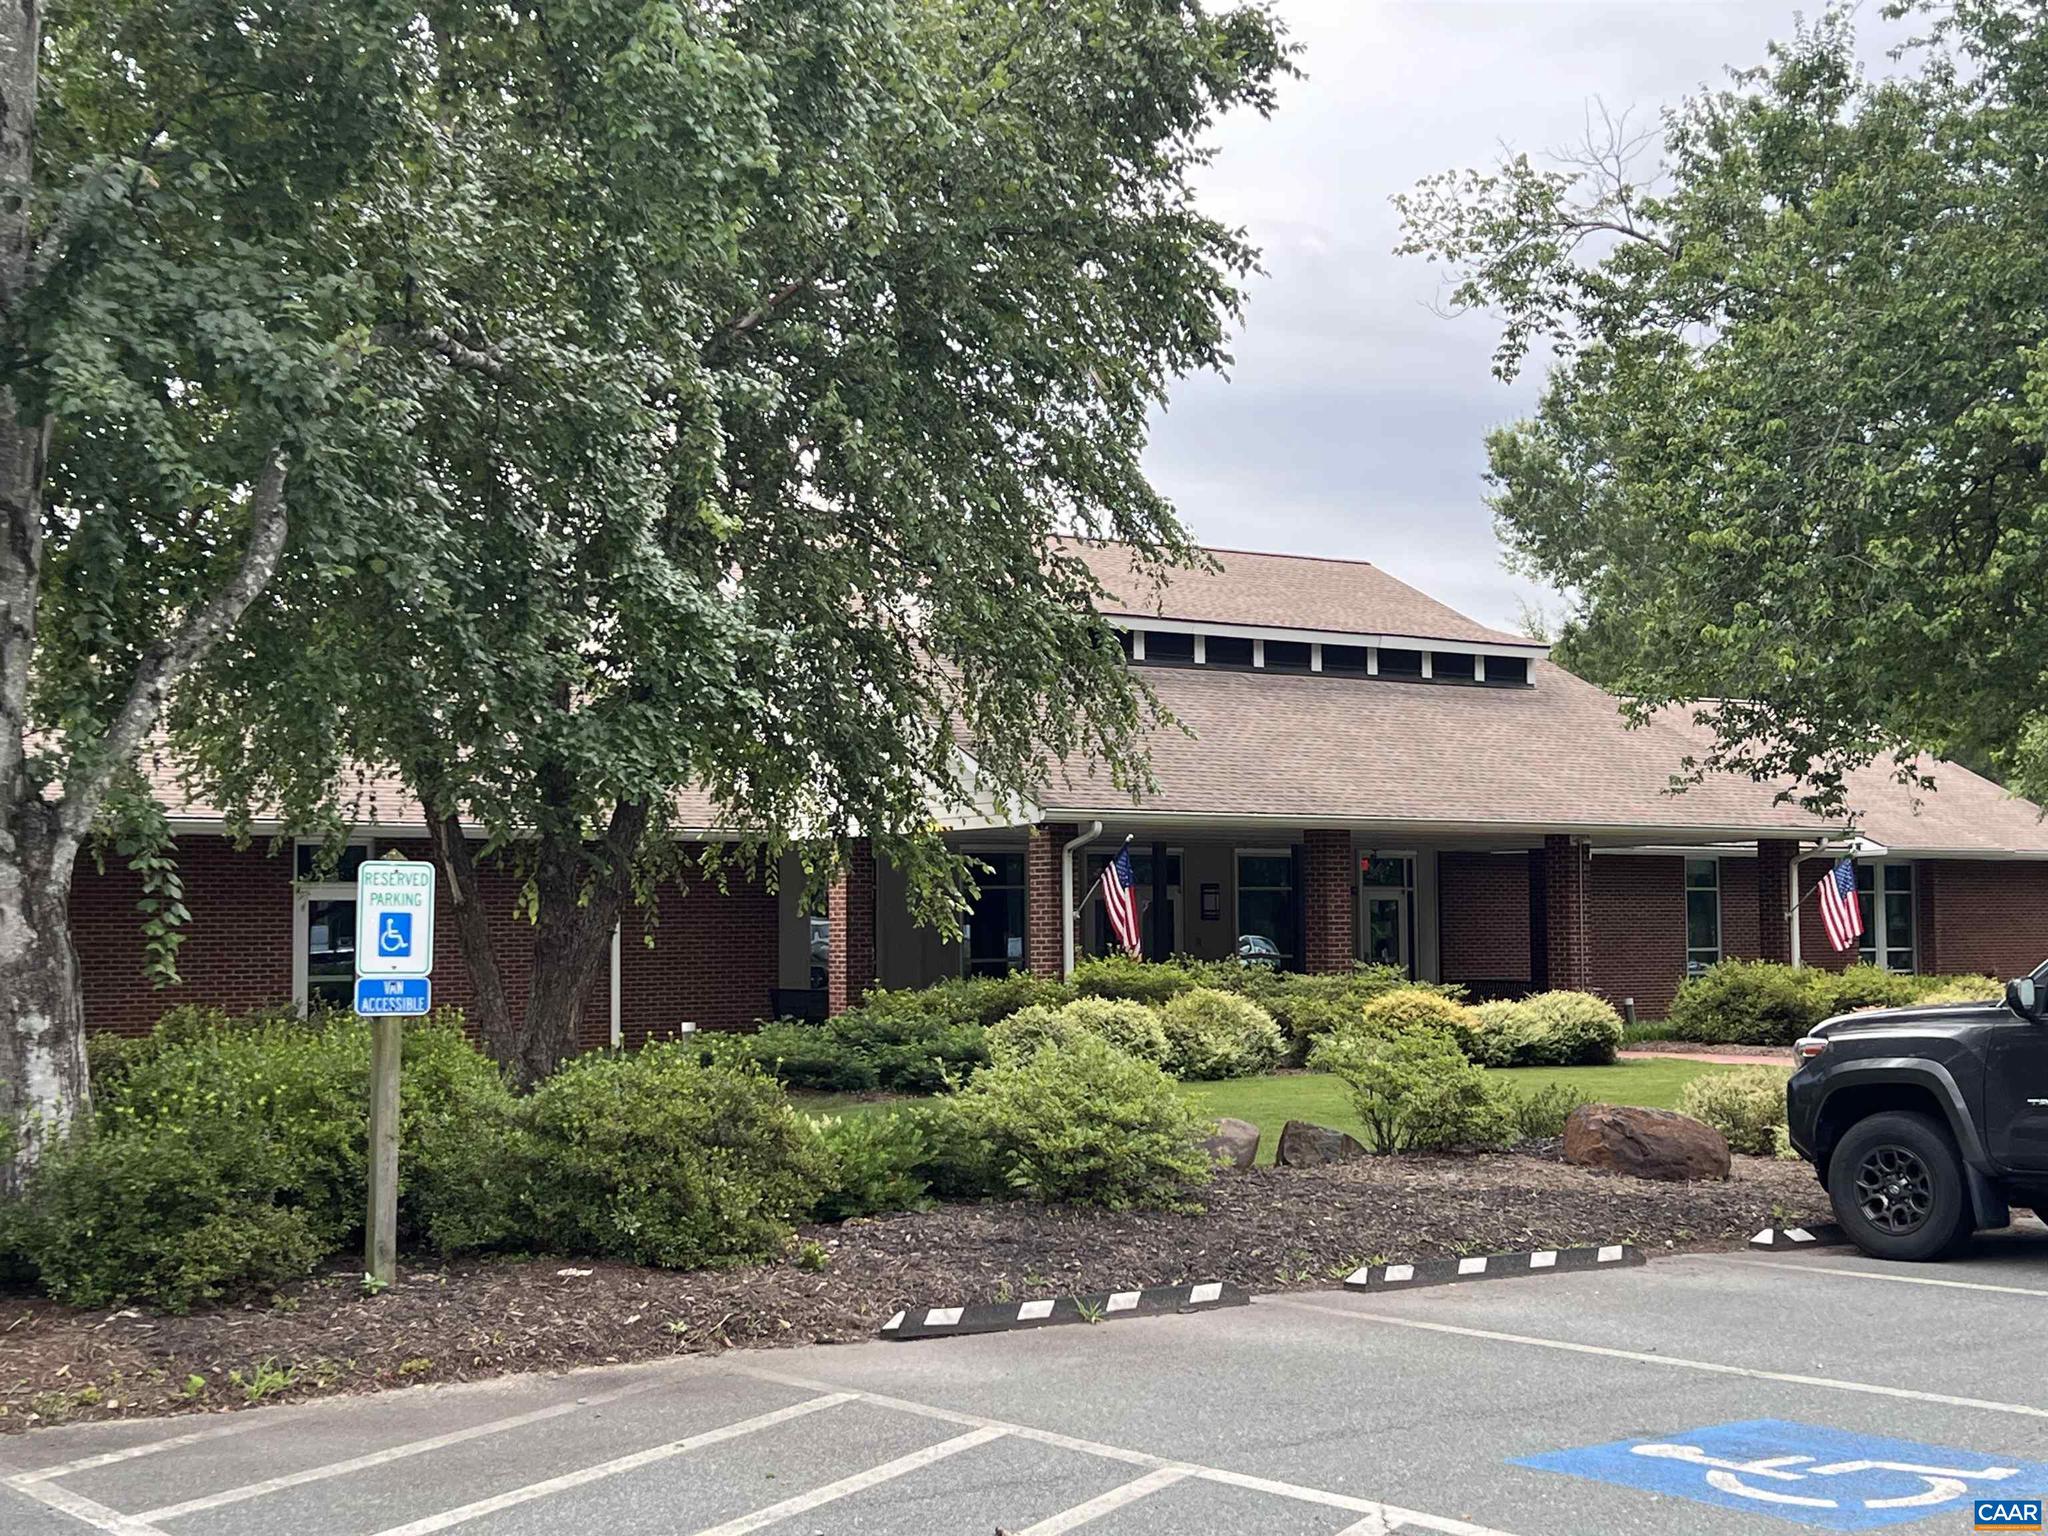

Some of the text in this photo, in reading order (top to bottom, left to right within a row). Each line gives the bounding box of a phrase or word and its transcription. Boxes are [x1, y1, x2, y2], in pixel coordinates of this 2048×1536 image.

[365, 872, 429, 886] RESERVED
[370, 892, 422, 906] PARKING
[383, 980, 404, 995] VAN
[361, 996, 425, 1012] ACCESSIBLE
